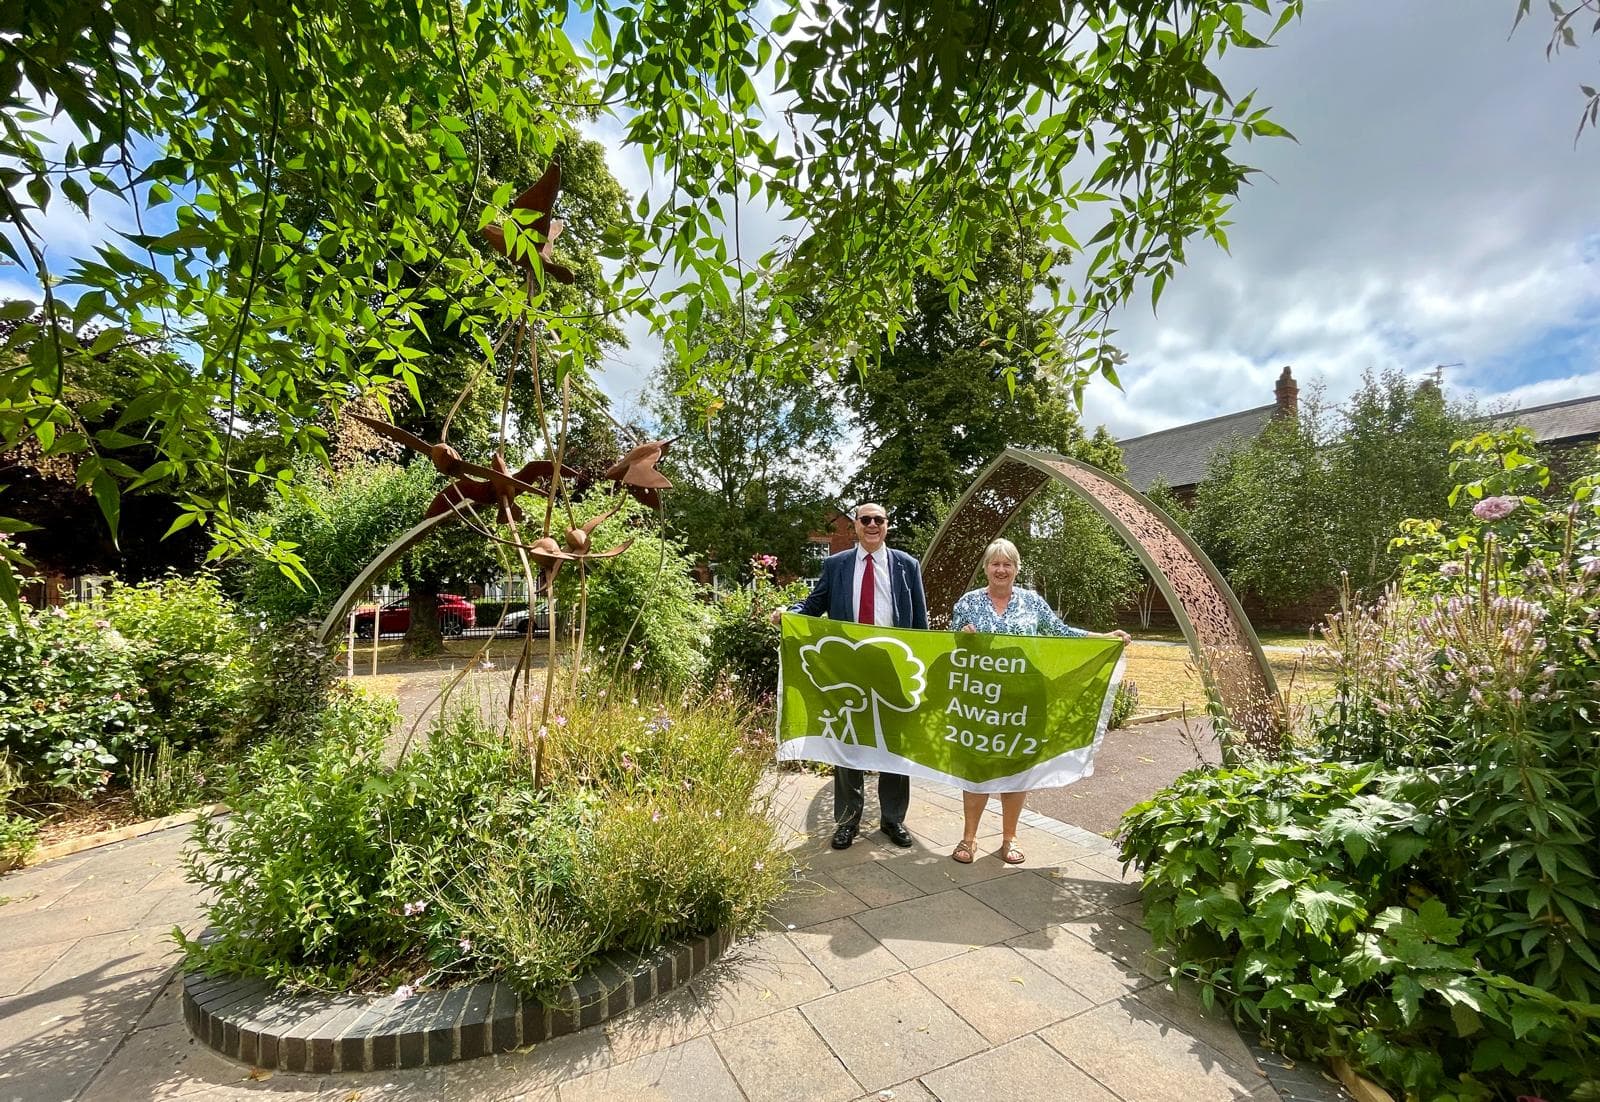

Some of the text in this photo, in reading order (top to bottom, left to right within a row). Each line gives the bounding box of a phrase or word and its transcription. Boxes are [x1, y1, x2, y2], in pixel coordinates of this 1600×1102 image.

[949, 648, 1026, 674] Green
[948, 671, 1002, 704] Flag
[945, 697, 1028, 727] Award
[944, 725, 1049, 757] 2026/2
